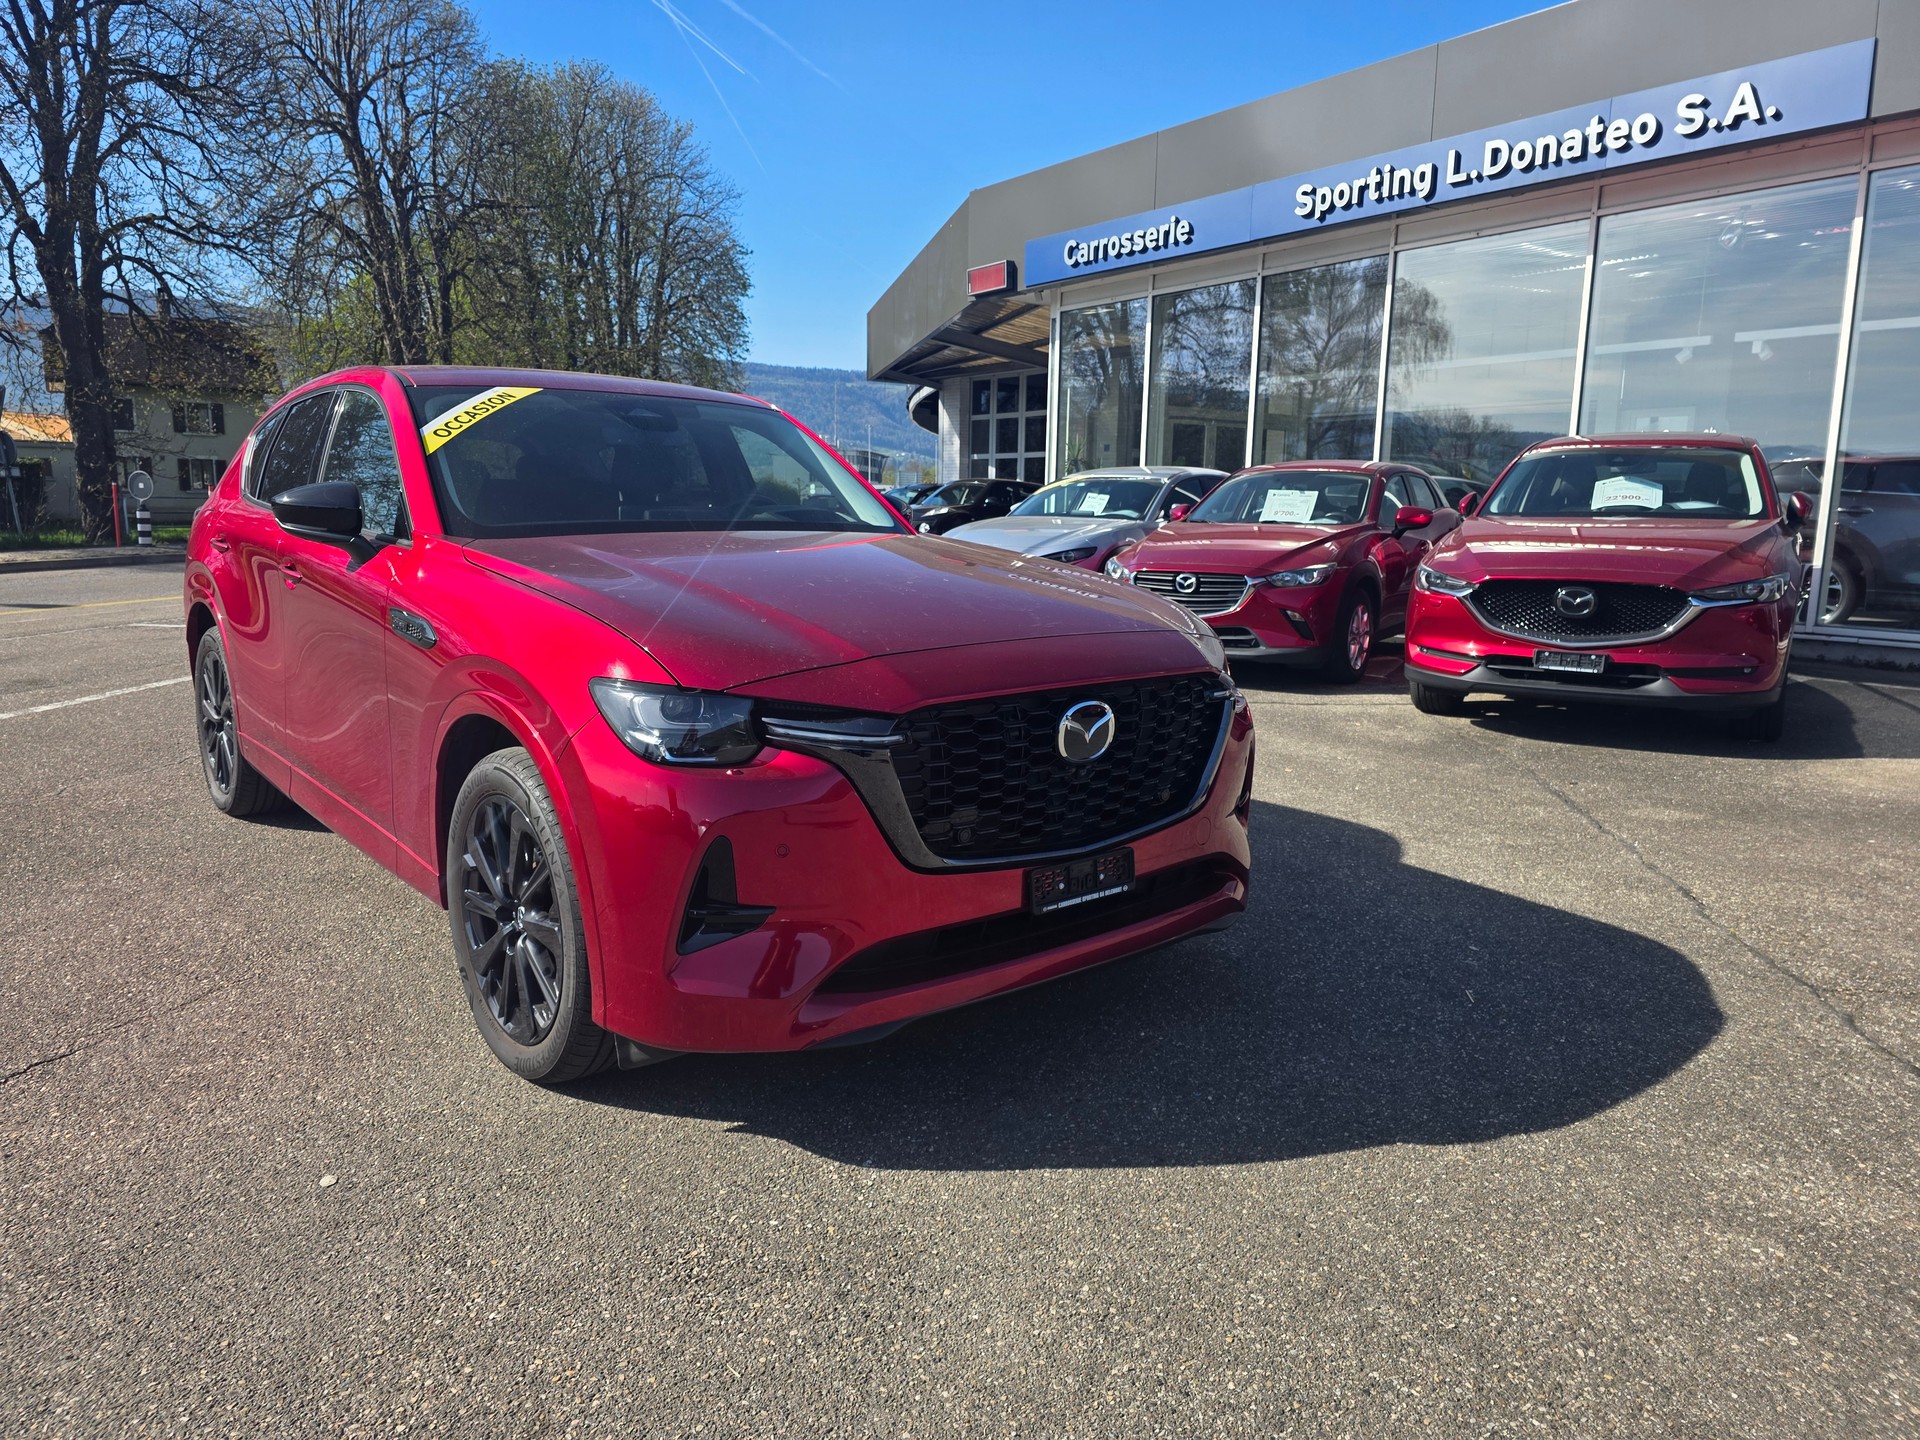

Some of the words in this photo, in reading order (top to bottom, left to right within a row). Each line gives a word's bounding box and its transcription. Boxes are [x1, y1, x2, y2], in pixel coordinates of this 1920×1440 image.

[1294, 163, 1436, 222] Sporting
[1674, 81, 1781, 138] S.A.
[1063, 215, 1193, 267] Carrosserie
[432, 391, 517, 438] OCCASION
[533, 815, 566, 899] ALENZA
